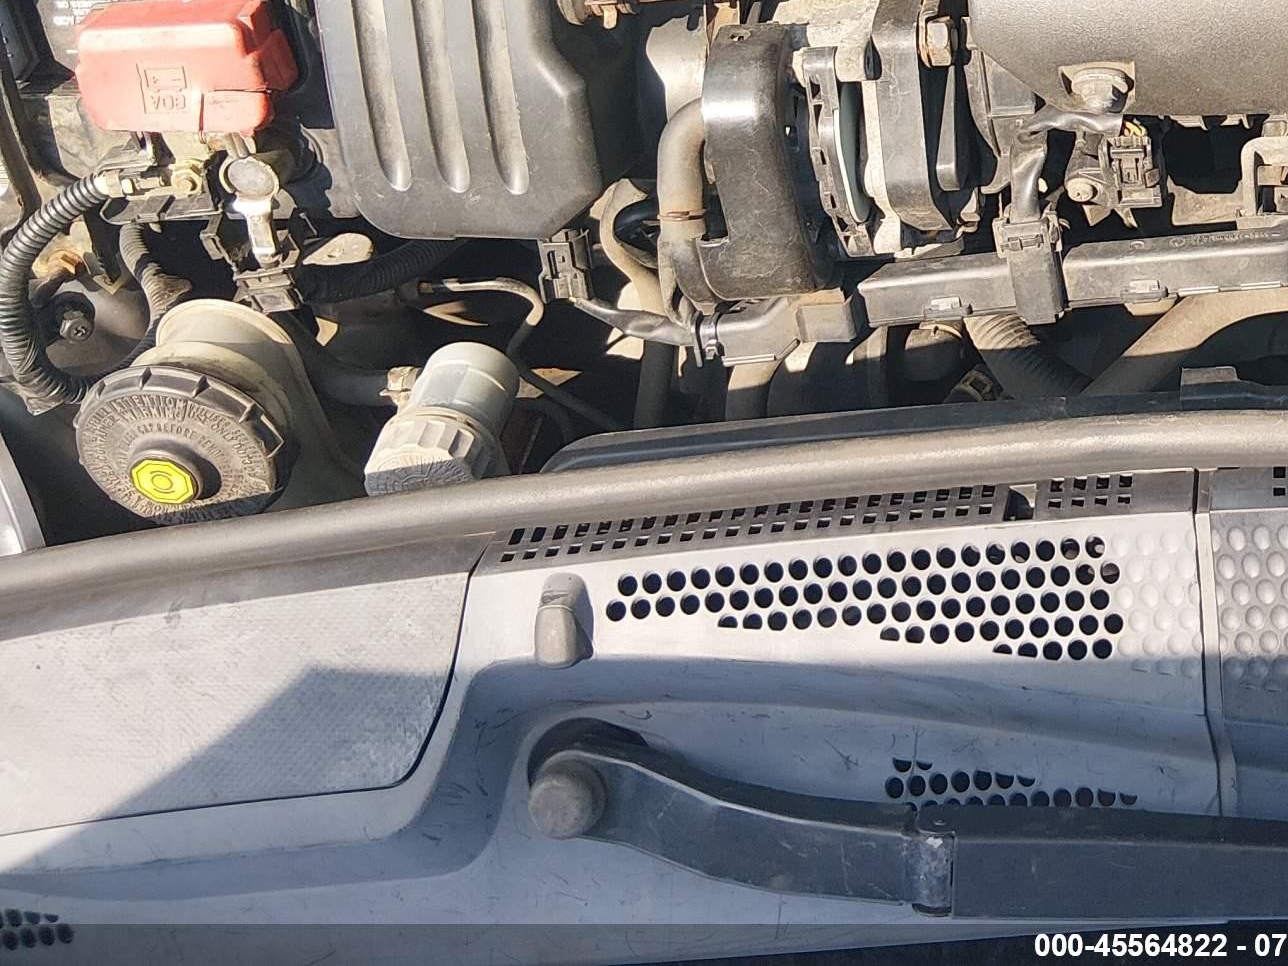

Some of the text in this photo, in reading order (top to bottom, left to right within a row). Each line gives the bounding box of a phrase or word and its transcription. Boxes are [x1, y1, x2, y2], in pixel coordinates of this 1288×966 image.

[111, 394, 186, 411] ATTENTION
[118, 405, 186, 423] WARNING
[209, 420, 237, 443] ONLY
